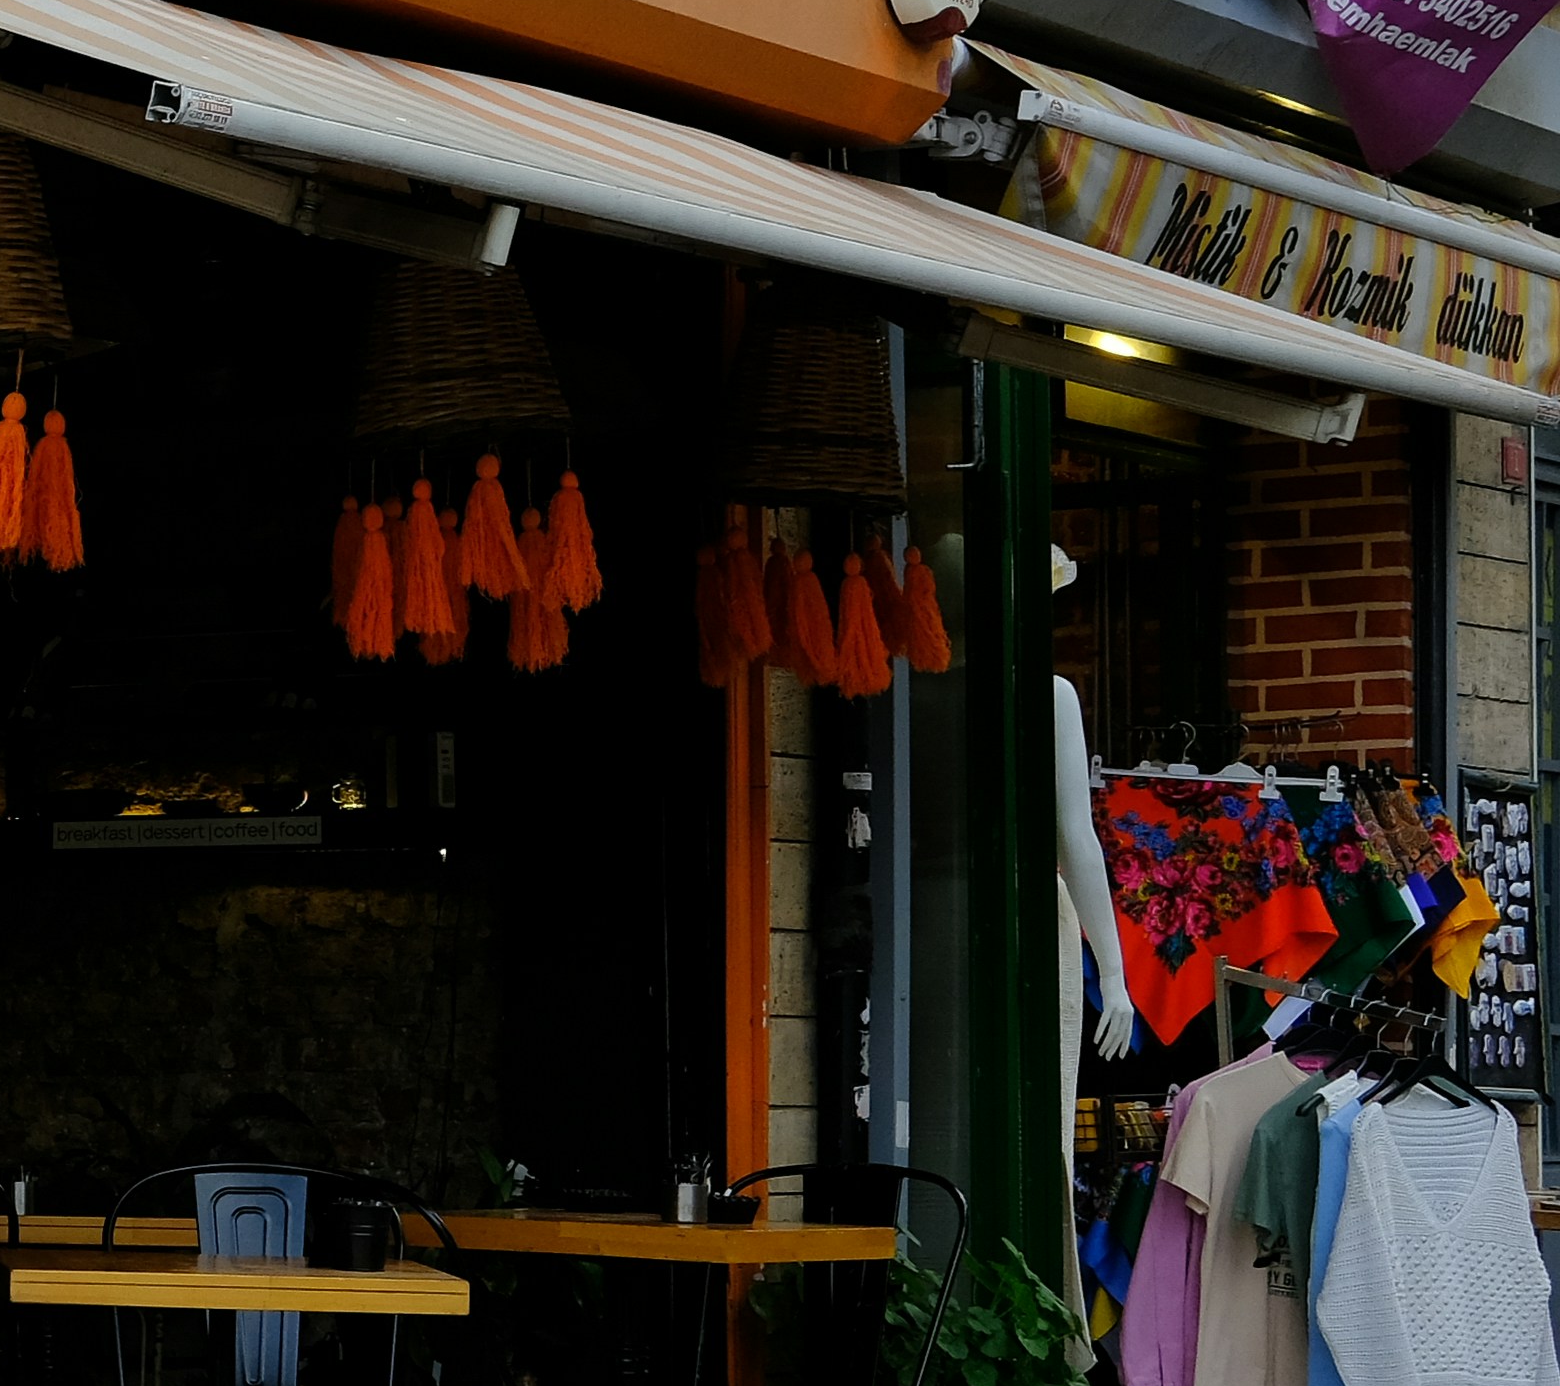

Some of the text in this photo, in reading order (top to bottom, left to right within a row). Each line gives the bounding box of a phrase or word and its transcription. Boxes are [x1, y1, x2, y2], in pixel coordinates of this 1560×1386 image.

[1260, 225, 1300, 301] &
[1304, 229, 1417, 334] Kozmik
[1434, 271, 1525, 364] dükkan
[57, 820, 318, 843] breakfast dessert coffee food
